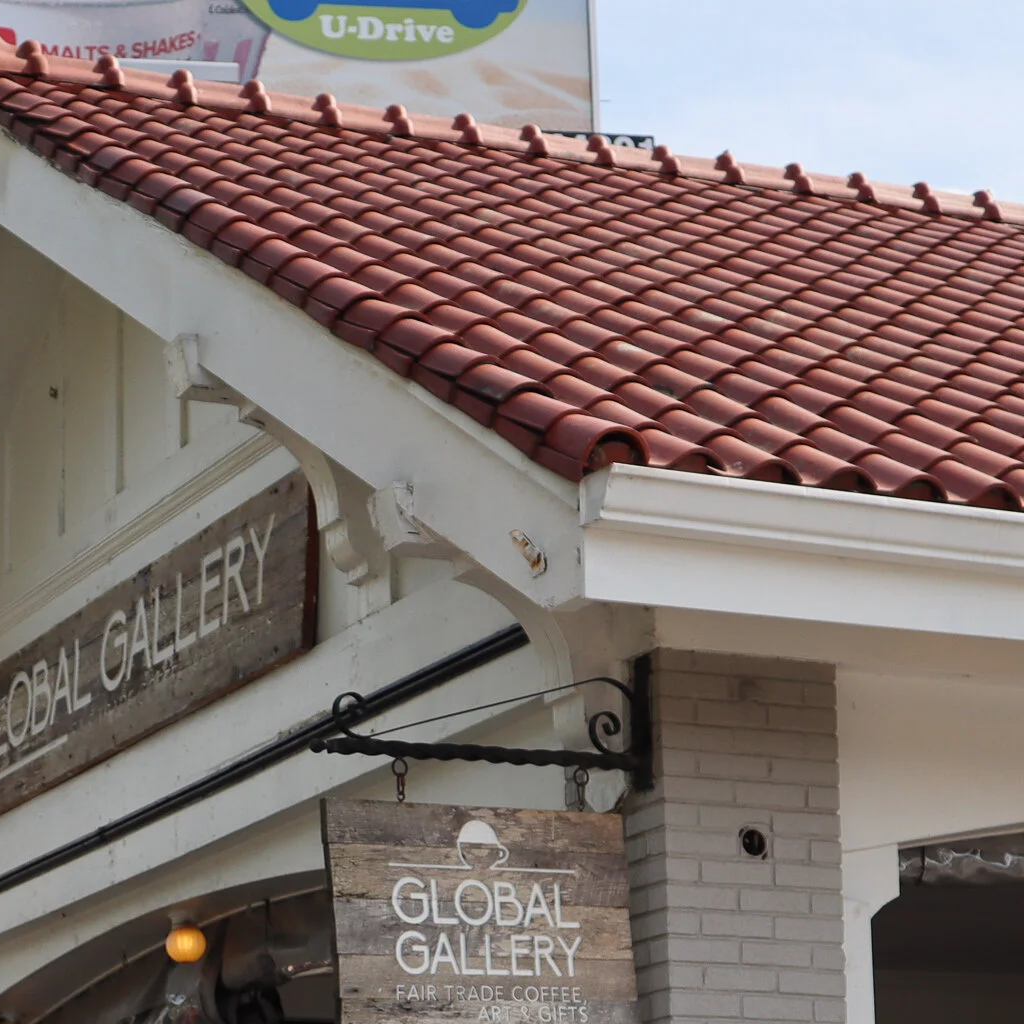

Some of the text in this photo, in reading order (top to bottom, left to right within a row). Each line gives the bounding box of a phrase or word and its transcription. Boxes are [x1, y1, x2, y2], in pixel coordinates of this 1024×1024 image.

[318, 14, 455, 43] U-Drive
[41, 30, 196, 61] MALTS & SHAKES
[100, 512, 276, 692] GALLERY
[391, 876, 581, 929] GLOBAL
[395, 930, 582, 978] GALLERY
[395, 984, 588, 1005] FAIR TRADE COFFEE,
[478, 1006, 589, 1023] ART & GIFTS
